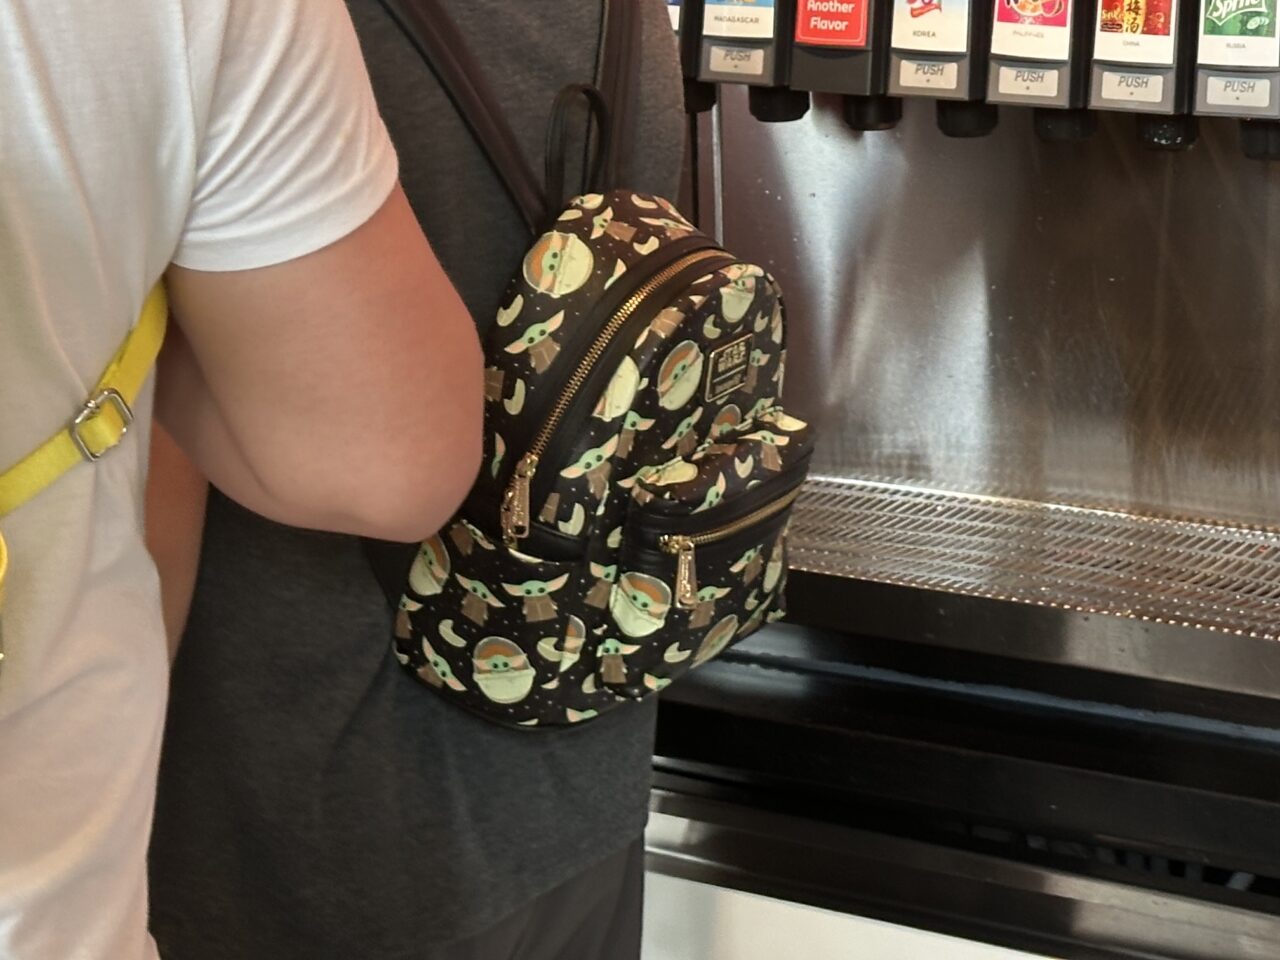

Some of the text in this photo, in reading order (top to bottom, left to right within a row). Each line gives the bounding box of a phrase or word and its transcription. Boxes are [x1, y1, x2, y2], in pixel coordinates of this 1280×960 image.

[807, 0, 855, 14] Another
[714, 15, 760, 24] MADAGASCAR
[810, 17, 848, 31] Flavor
[723, 50, 752, 62] PUSH
[915, 64, 945, 76] PUSH
[1014, 71, 1045, 83] PUSH
[1118, 76, 1149, 88] PUSH
[1223, 80, 1256, 93] PUSH
